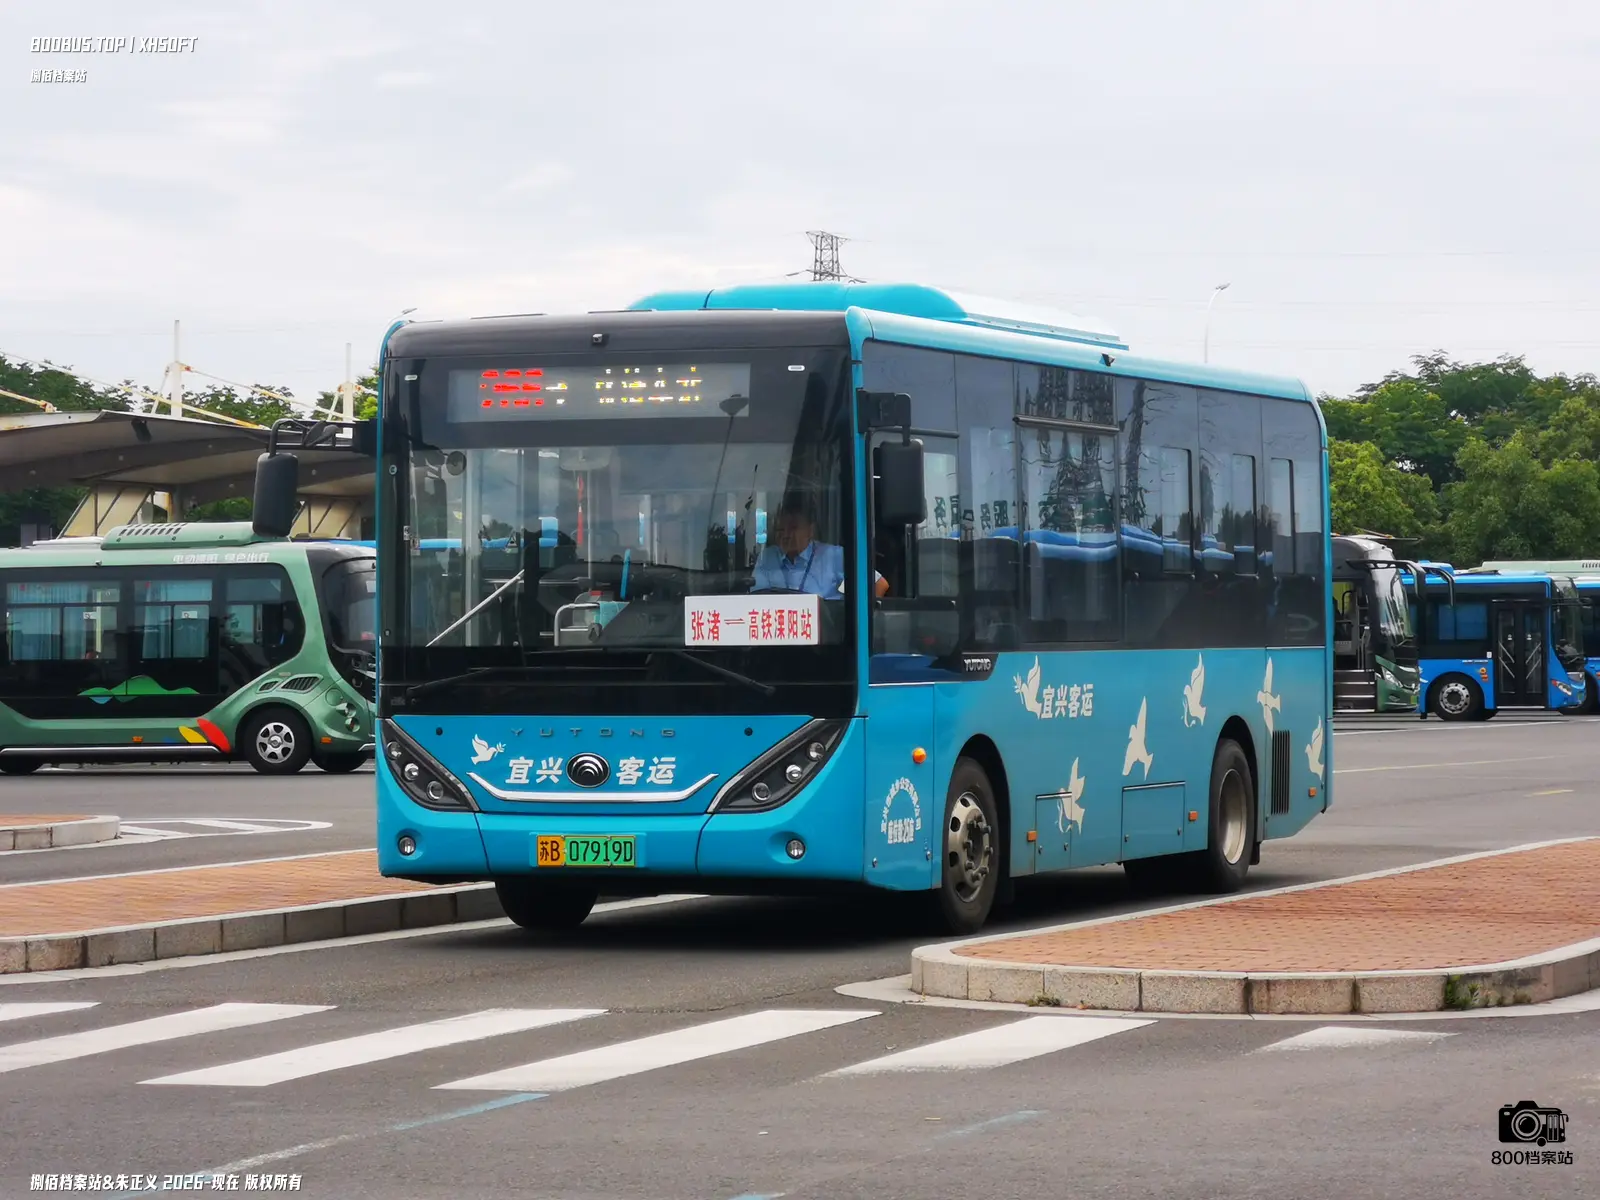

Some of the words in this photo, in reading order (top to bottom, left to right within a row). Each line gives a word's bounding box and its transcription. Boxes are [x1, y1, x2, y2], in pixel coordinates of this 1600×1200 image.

[691, 609, 721, 641] 张渚
[748, 608, 812, 640] 高铁溧阳站
[964, 658, 992, 672] YUTONG
[1041, 683, 1094, 718] 宜兴客运
[510, 727, 676, 737] YUTONG
[505, 756, 563, 784] 宜兴
[616, 756, 676, 785] 客运
